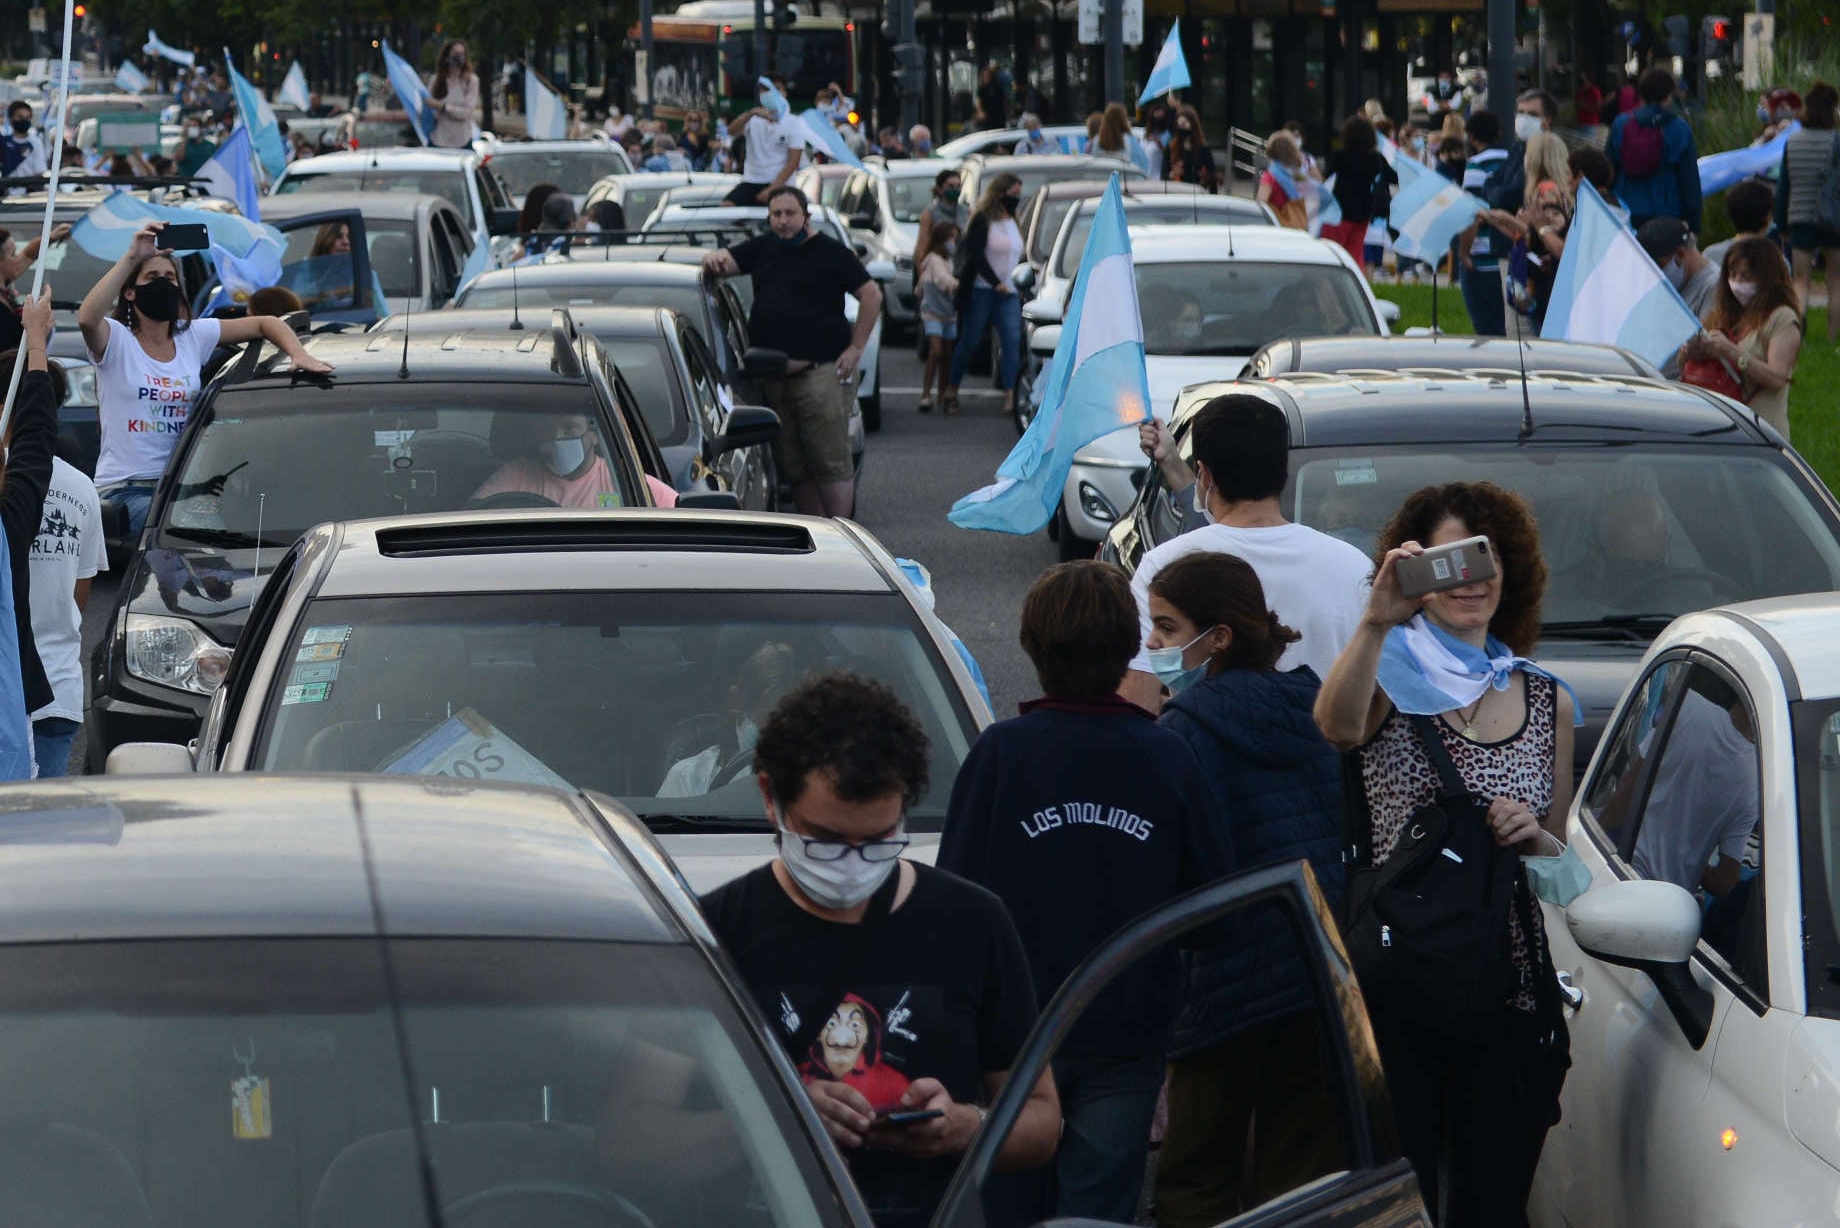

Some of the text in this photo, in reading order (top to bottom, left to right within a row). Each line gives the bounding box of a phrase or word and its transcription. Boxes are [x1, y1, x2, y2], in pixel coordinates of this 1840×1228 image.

[145, 374, 191, 388] TREAT
[150, 404, 186, 418] WITH
[48, 489, 88, 516] DERNESS
[1020, 802, 1155, 841] LOS MOLINOS
